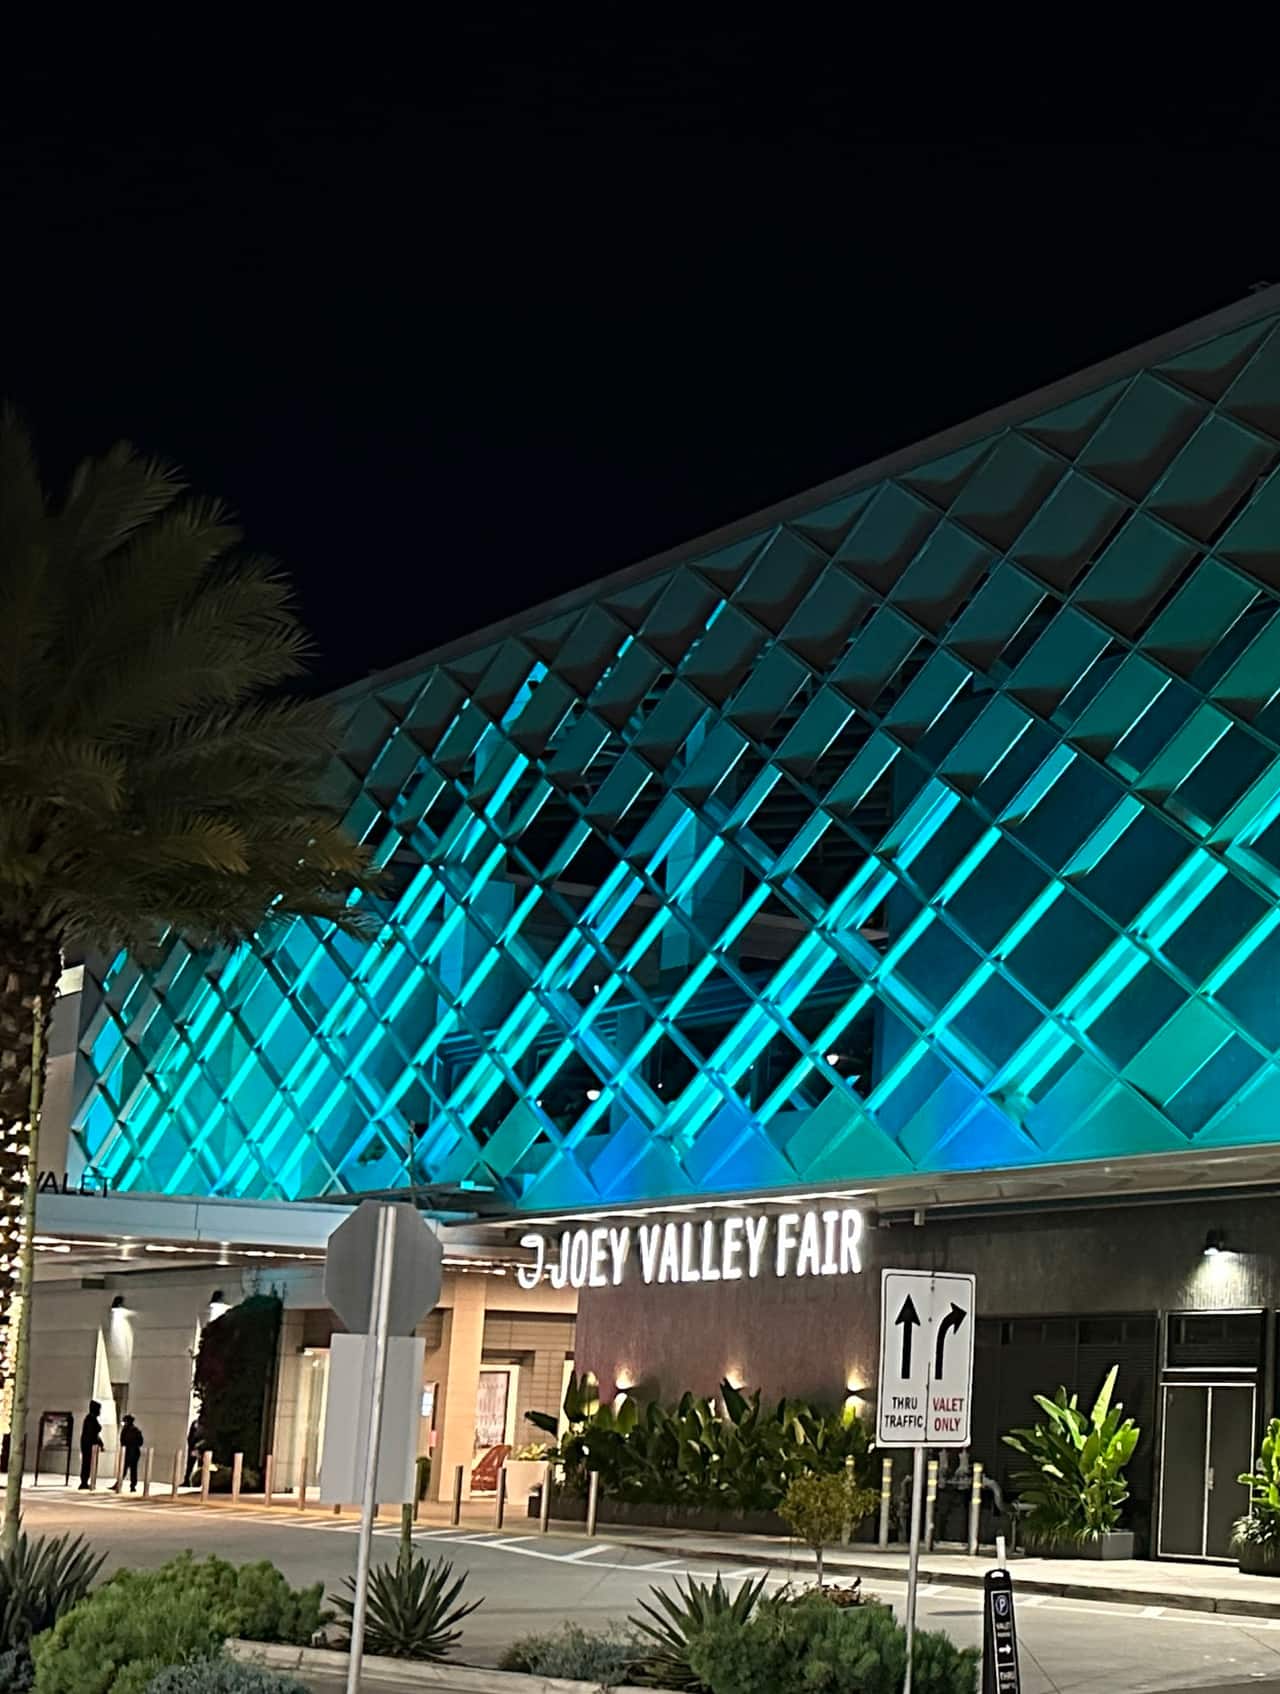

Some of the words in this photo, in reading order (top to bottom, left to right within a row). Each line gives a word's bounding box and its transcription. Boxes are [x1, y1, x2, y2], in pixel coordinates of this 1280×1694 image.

[548, 1226, 630, 1289] JOEY
[639, 1215, 769, 1284] VALLEY
[775, 1208, 863, 1277] FAIR
[892, 1396, 918, 1410] THRU
[932, 1397, 964, 1412] VALET
[885, 1414, 924, 1429] TRAFFIC
[934, 1417, 961, 1432] ONLY
